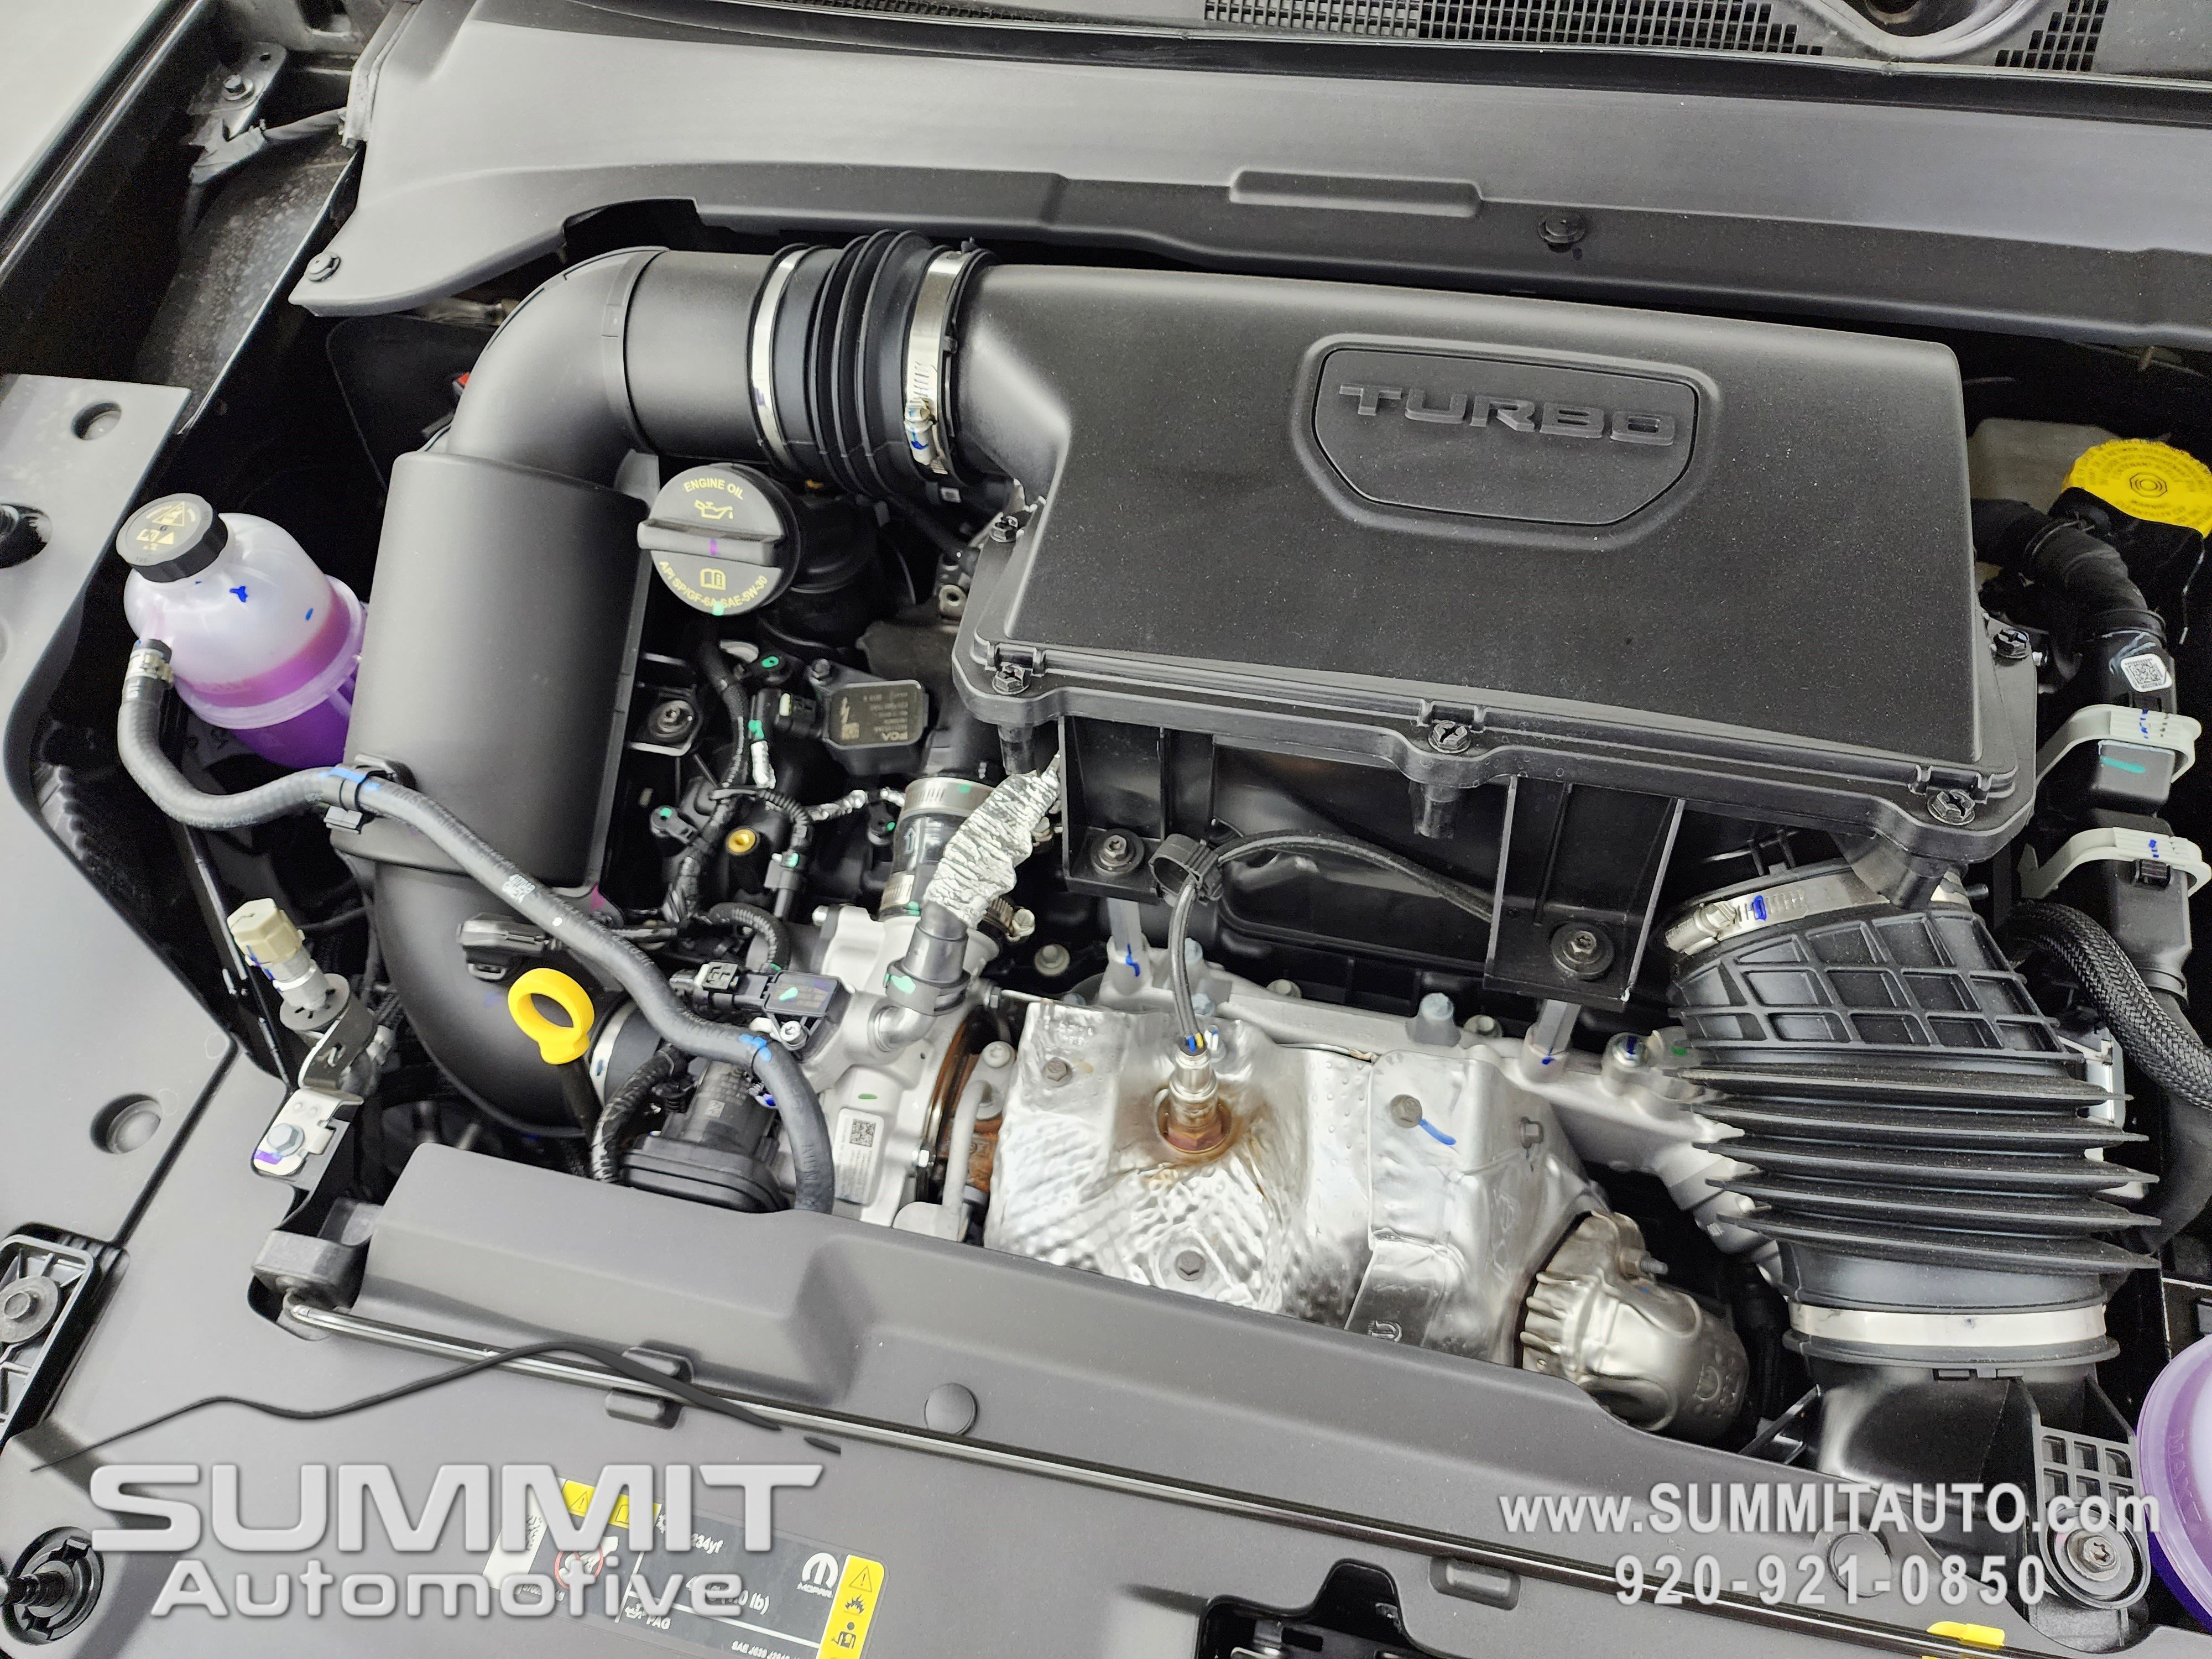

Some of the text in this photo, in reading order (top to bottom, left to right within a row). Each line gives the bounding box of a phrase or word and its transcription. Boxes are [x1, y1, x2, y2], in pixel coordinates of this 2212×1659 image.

[1339, 382, 1676, 446] TURBO
[683, 478, 744, 500] ENGINE OIL
[659, 561, 675, 580] API
[749, 1592, 769, 1615] lb)
[646, 1615, 671, 1630] PAG
[731, 1640, 749, 1653] SAE
